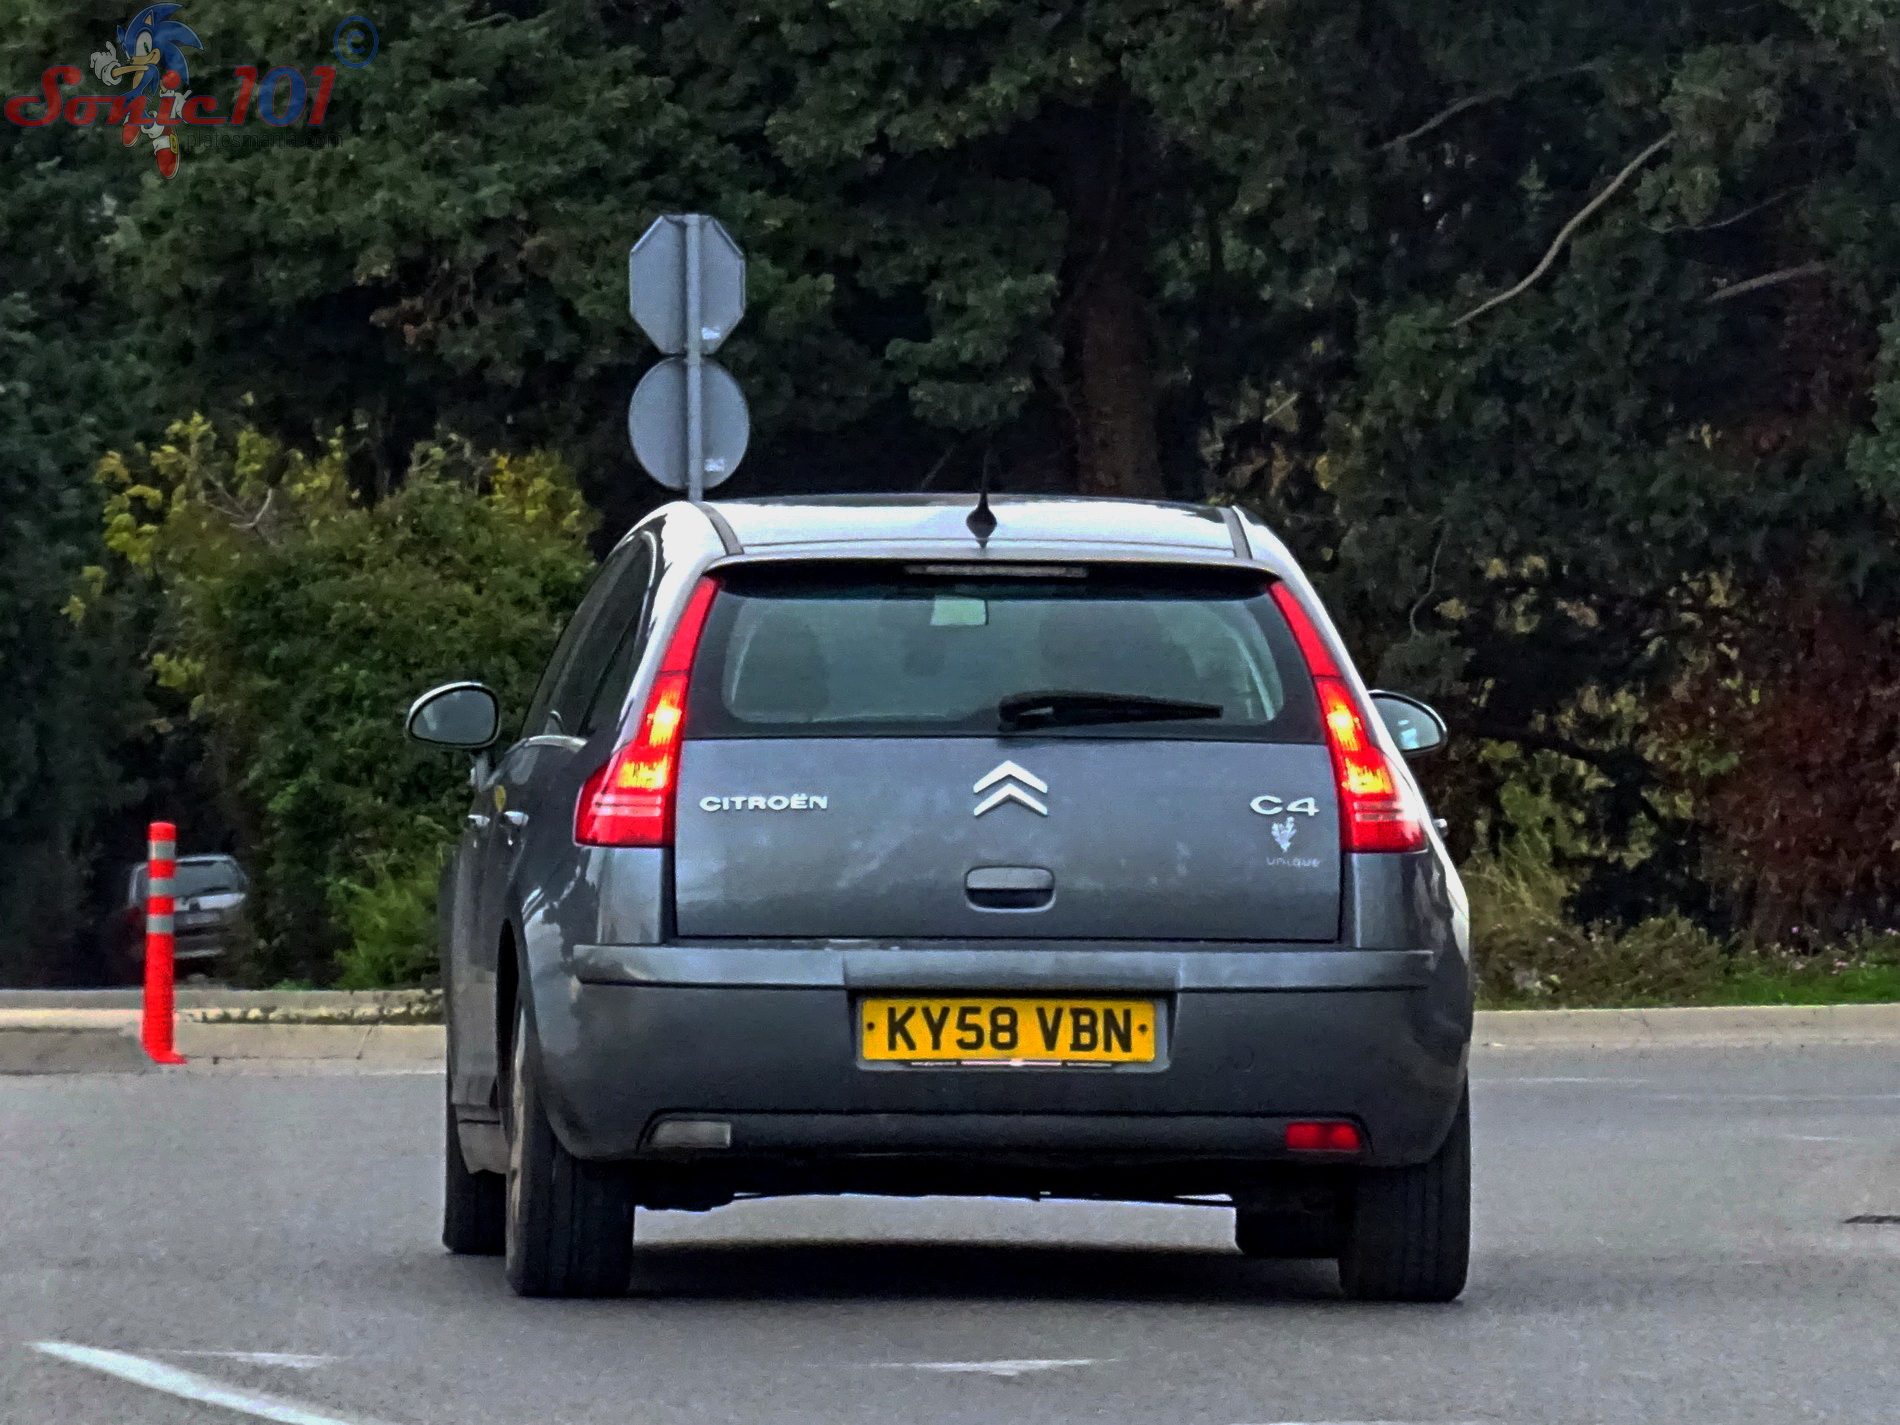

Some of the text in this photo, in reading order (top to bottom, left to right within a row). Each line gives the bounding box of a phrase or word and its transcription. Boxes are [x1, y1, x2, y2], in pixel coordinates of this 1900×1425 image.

[699, 793, 828, 812] CITROËN
[1250, 795, 1320, 816] C4
[887, 1006, 1133, 1053] KY58 VBN
